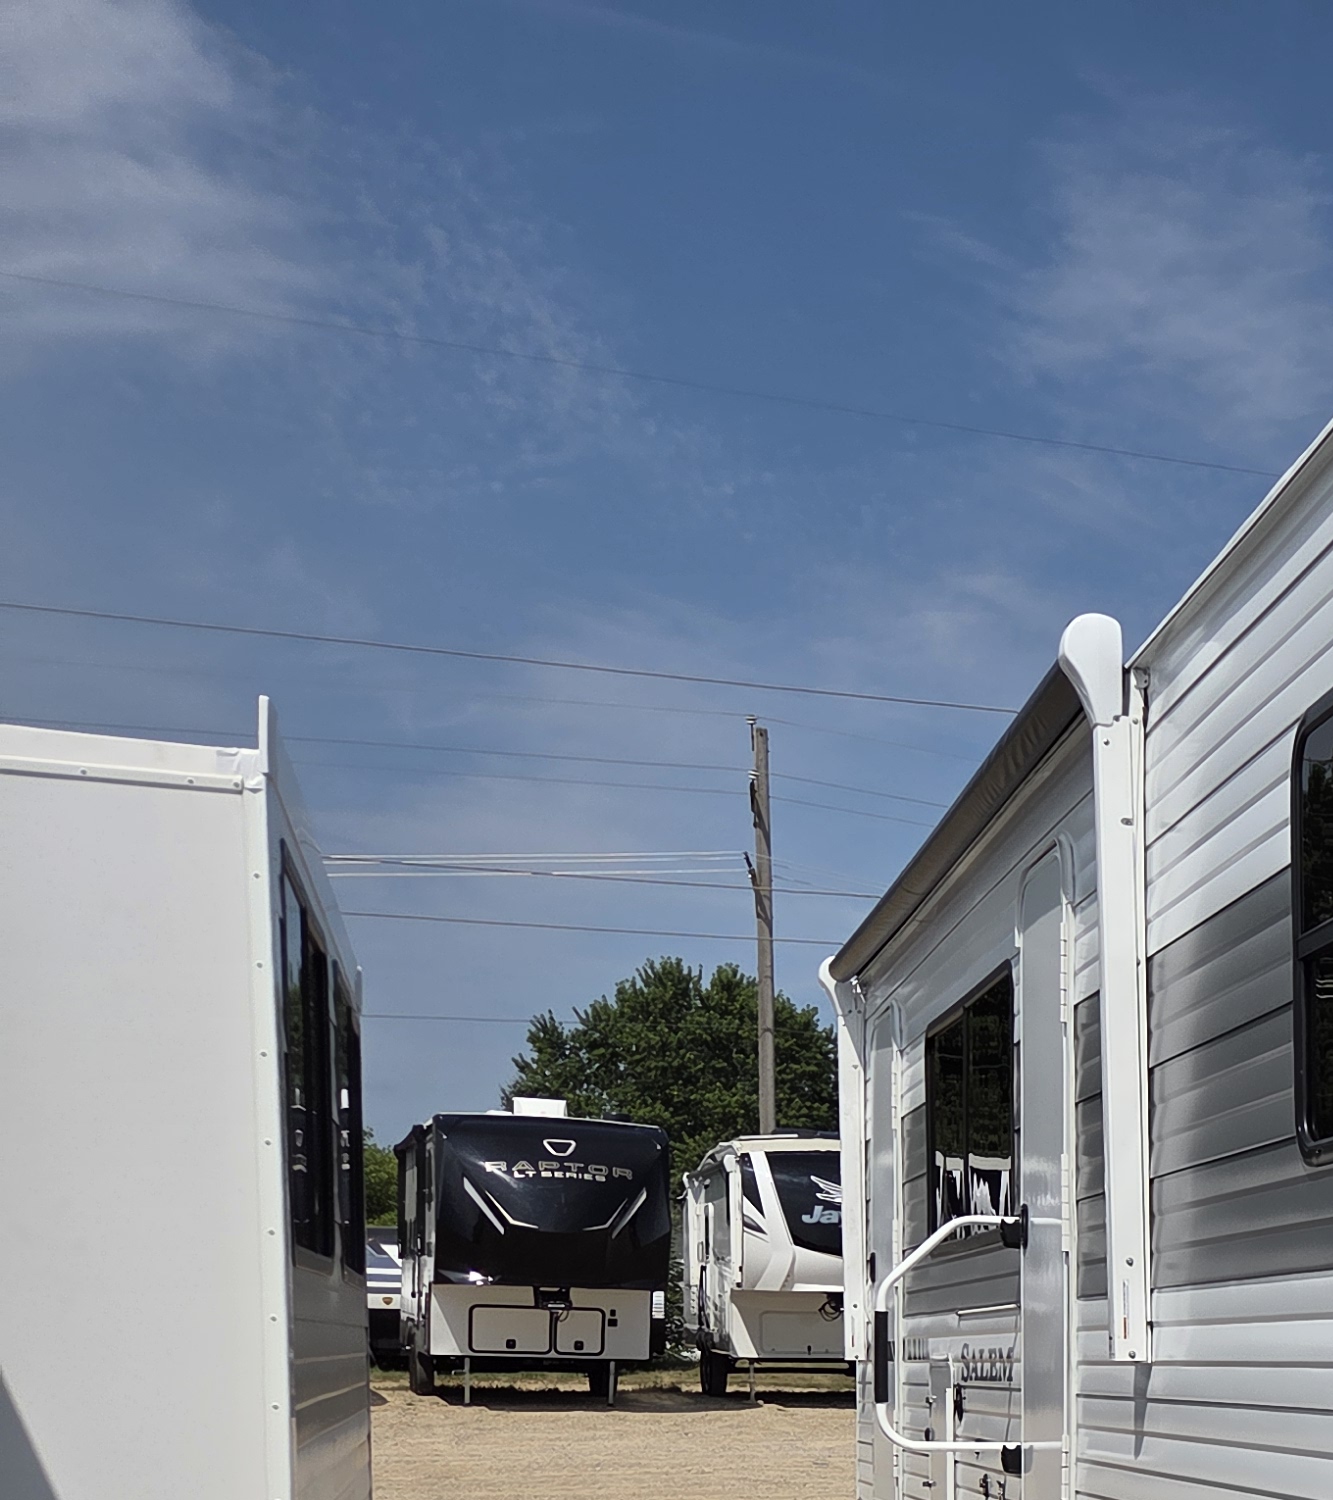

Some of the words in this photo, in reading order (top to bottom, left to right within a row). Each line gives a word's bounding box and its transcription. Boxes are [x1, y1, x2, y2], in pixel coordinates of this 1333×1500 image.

[484, 1160, 633, 1181] RAPTOR
[513, 1170, 537, 1179] LT
[540, 1171, 607, 1182] SERIES
[801, 1205, 842, 1228] Ja
[960, 1342, 1015, 1383] SALEM
